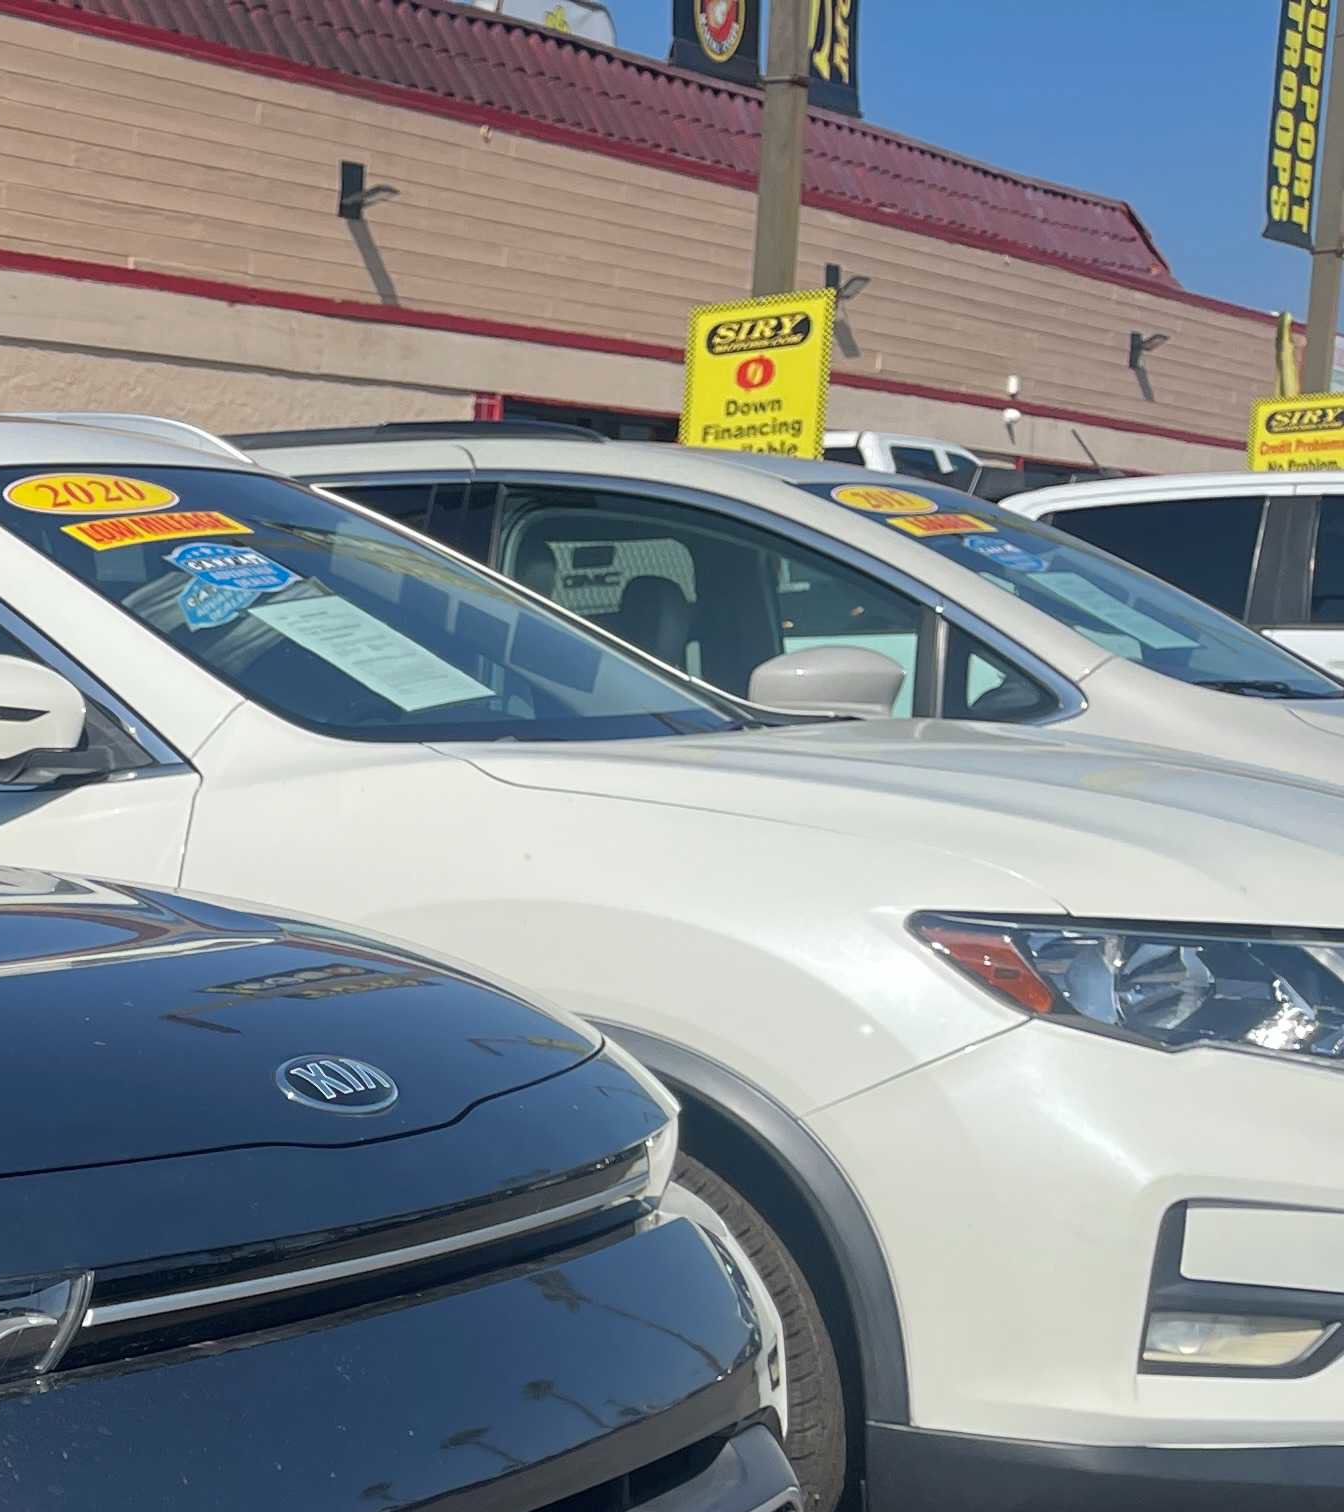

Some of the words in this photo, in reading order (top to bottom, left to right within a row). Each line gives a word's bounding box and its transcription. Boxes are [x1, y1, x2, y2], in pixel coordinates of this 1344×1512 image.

[1292, 0, 1327, 234] UPPORT
[714, 314, 806, 344] SIRY
[725, 398, 783, 417] Down
[702, 418, 803, 443] Financing
[35, 478, 145, 508] 2020
[78, 518, 137, 543] LOW
[136, 512, 238, 537] MILEAGE
[290, 1058, 391, 1100] KIA
